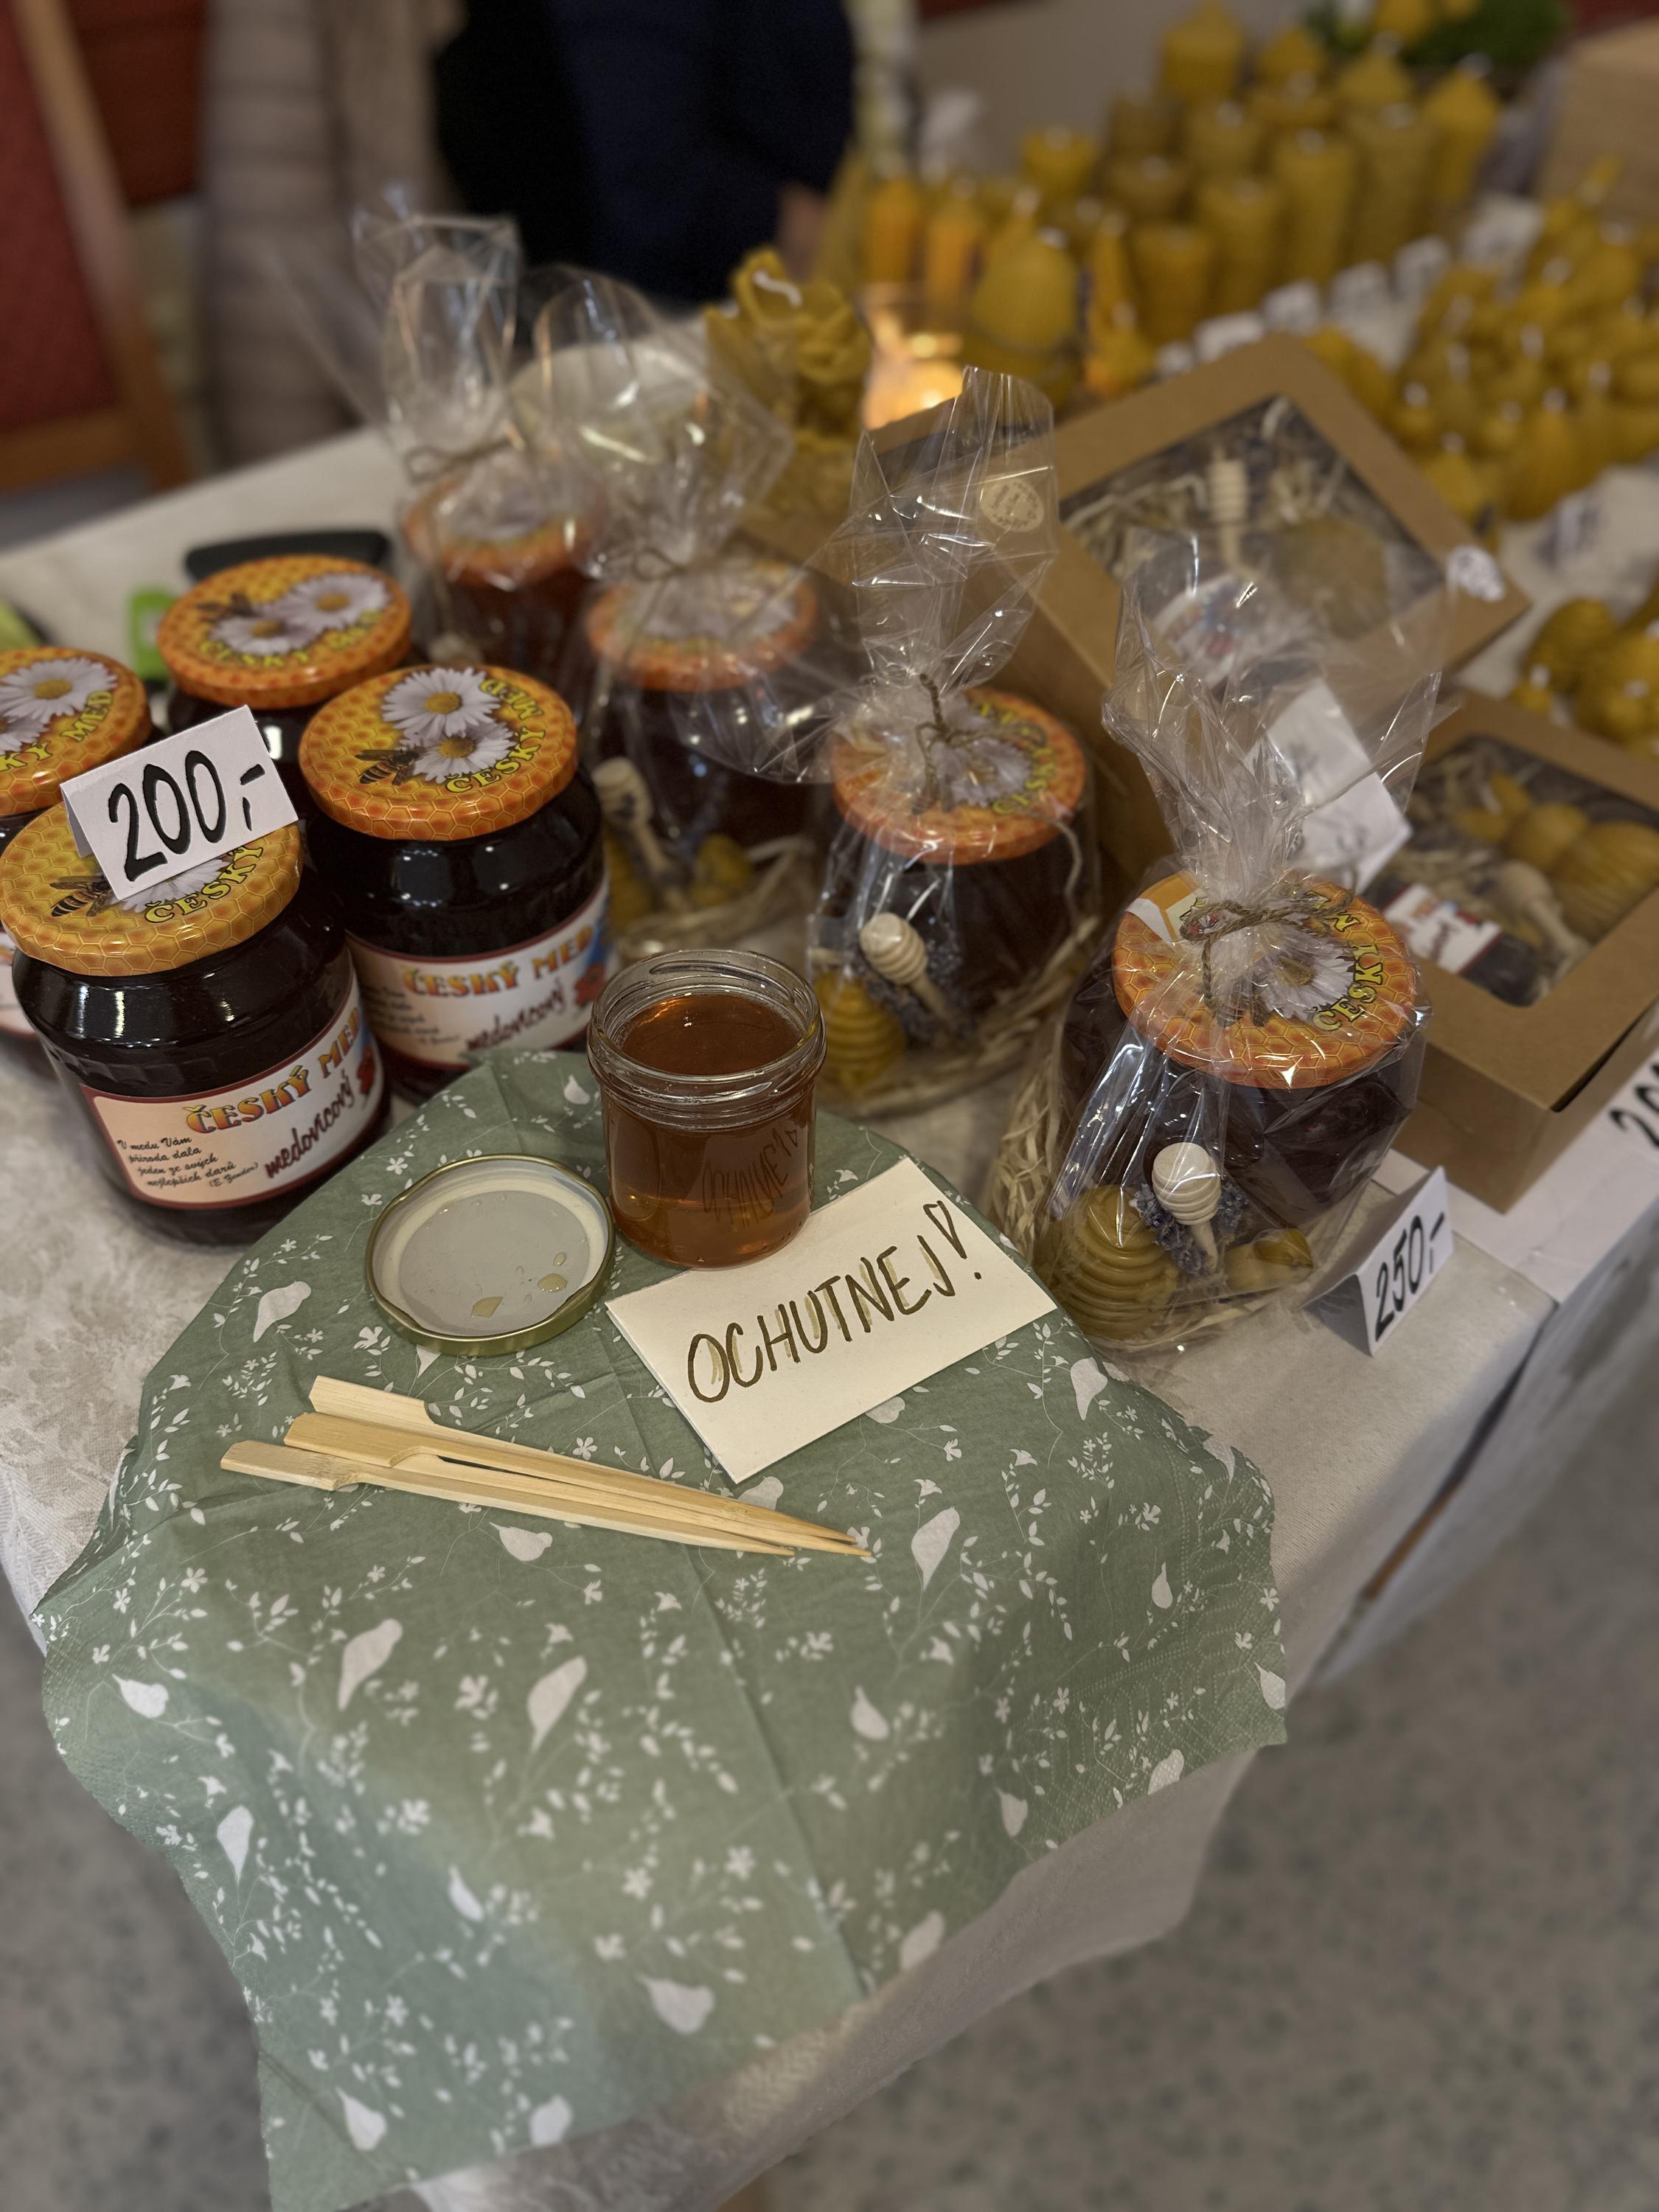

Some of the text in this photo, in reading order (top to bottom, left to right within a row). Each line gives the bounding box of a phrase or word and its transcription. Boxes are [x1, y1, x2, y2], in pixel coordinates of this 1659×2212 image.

[60, 690, 113, 742] MED
[479, 678, 544, 720] MED
[108, 750, 265, 883] 200,-
[183, 1065, 312, 1134] ČESKÝ
[117, 1136, 192, 1150] V medu Vám
[138, 1152, 218, 1176] jeden ze svých
[173, 1147, 203, 1160] dala
[206, 1161, 236, 1178] darů
[686, 1200, 982, 1403] OCHUTNEJ!
